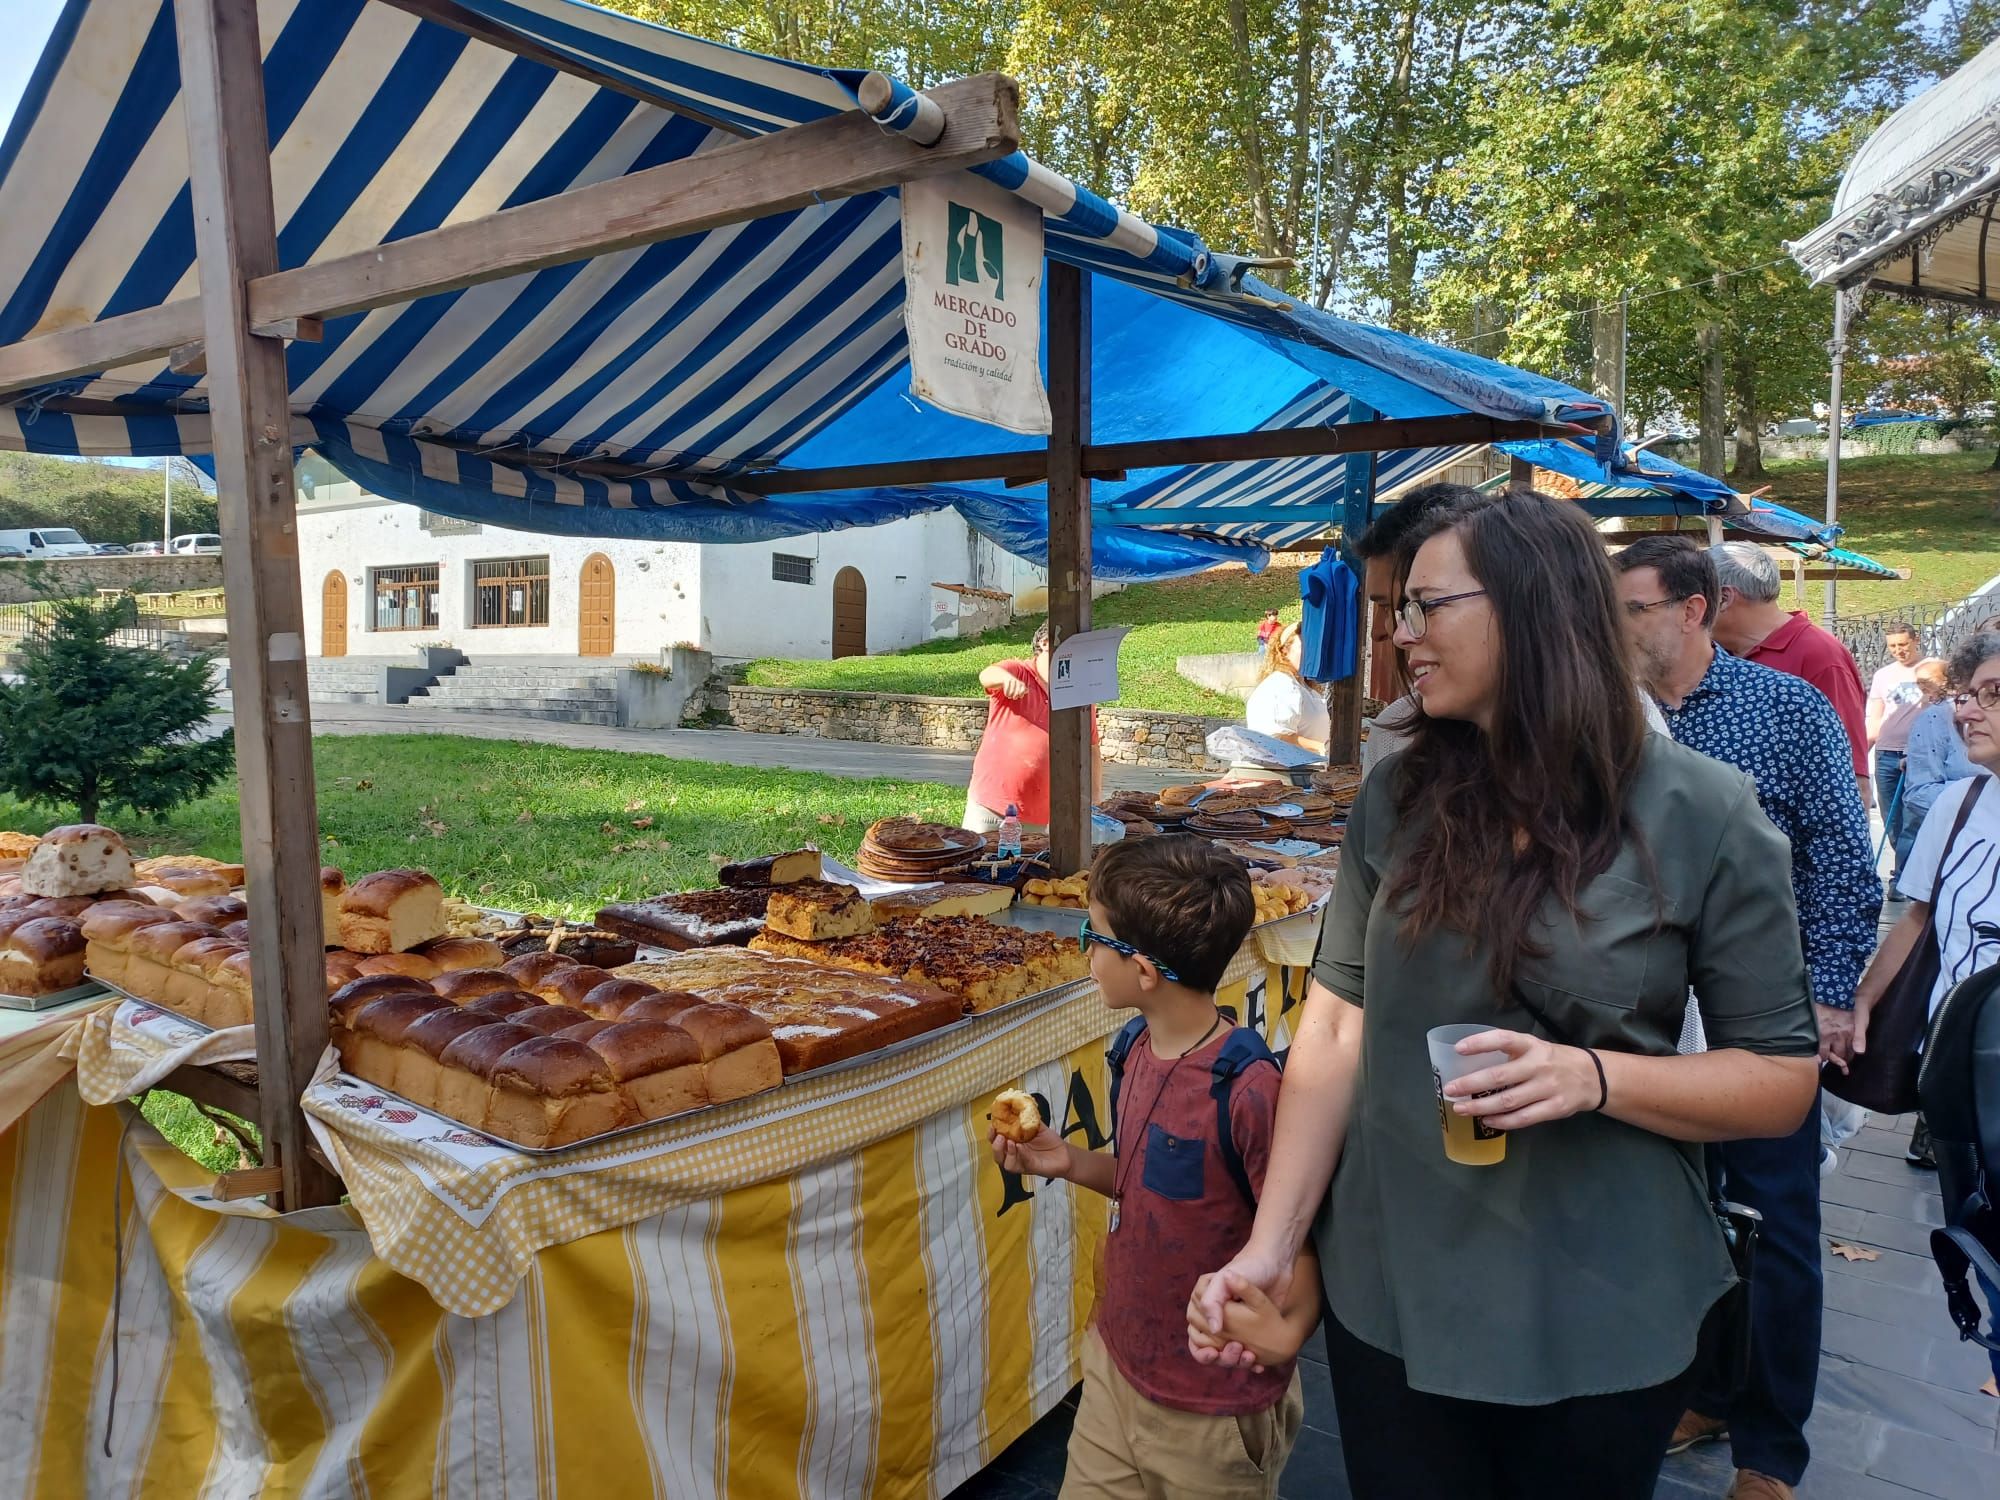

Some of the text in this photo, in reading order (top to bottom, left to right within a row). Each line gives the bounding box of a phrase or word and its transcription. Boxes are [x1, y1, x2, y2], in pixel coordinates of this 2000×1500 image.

[934, 290, 1016, 327] MERCADO
[964, 318, 987, 339] DE
[945, 332, 1006, 362] GRADO
[943, 356, 1013, 383] tradición y calidad
